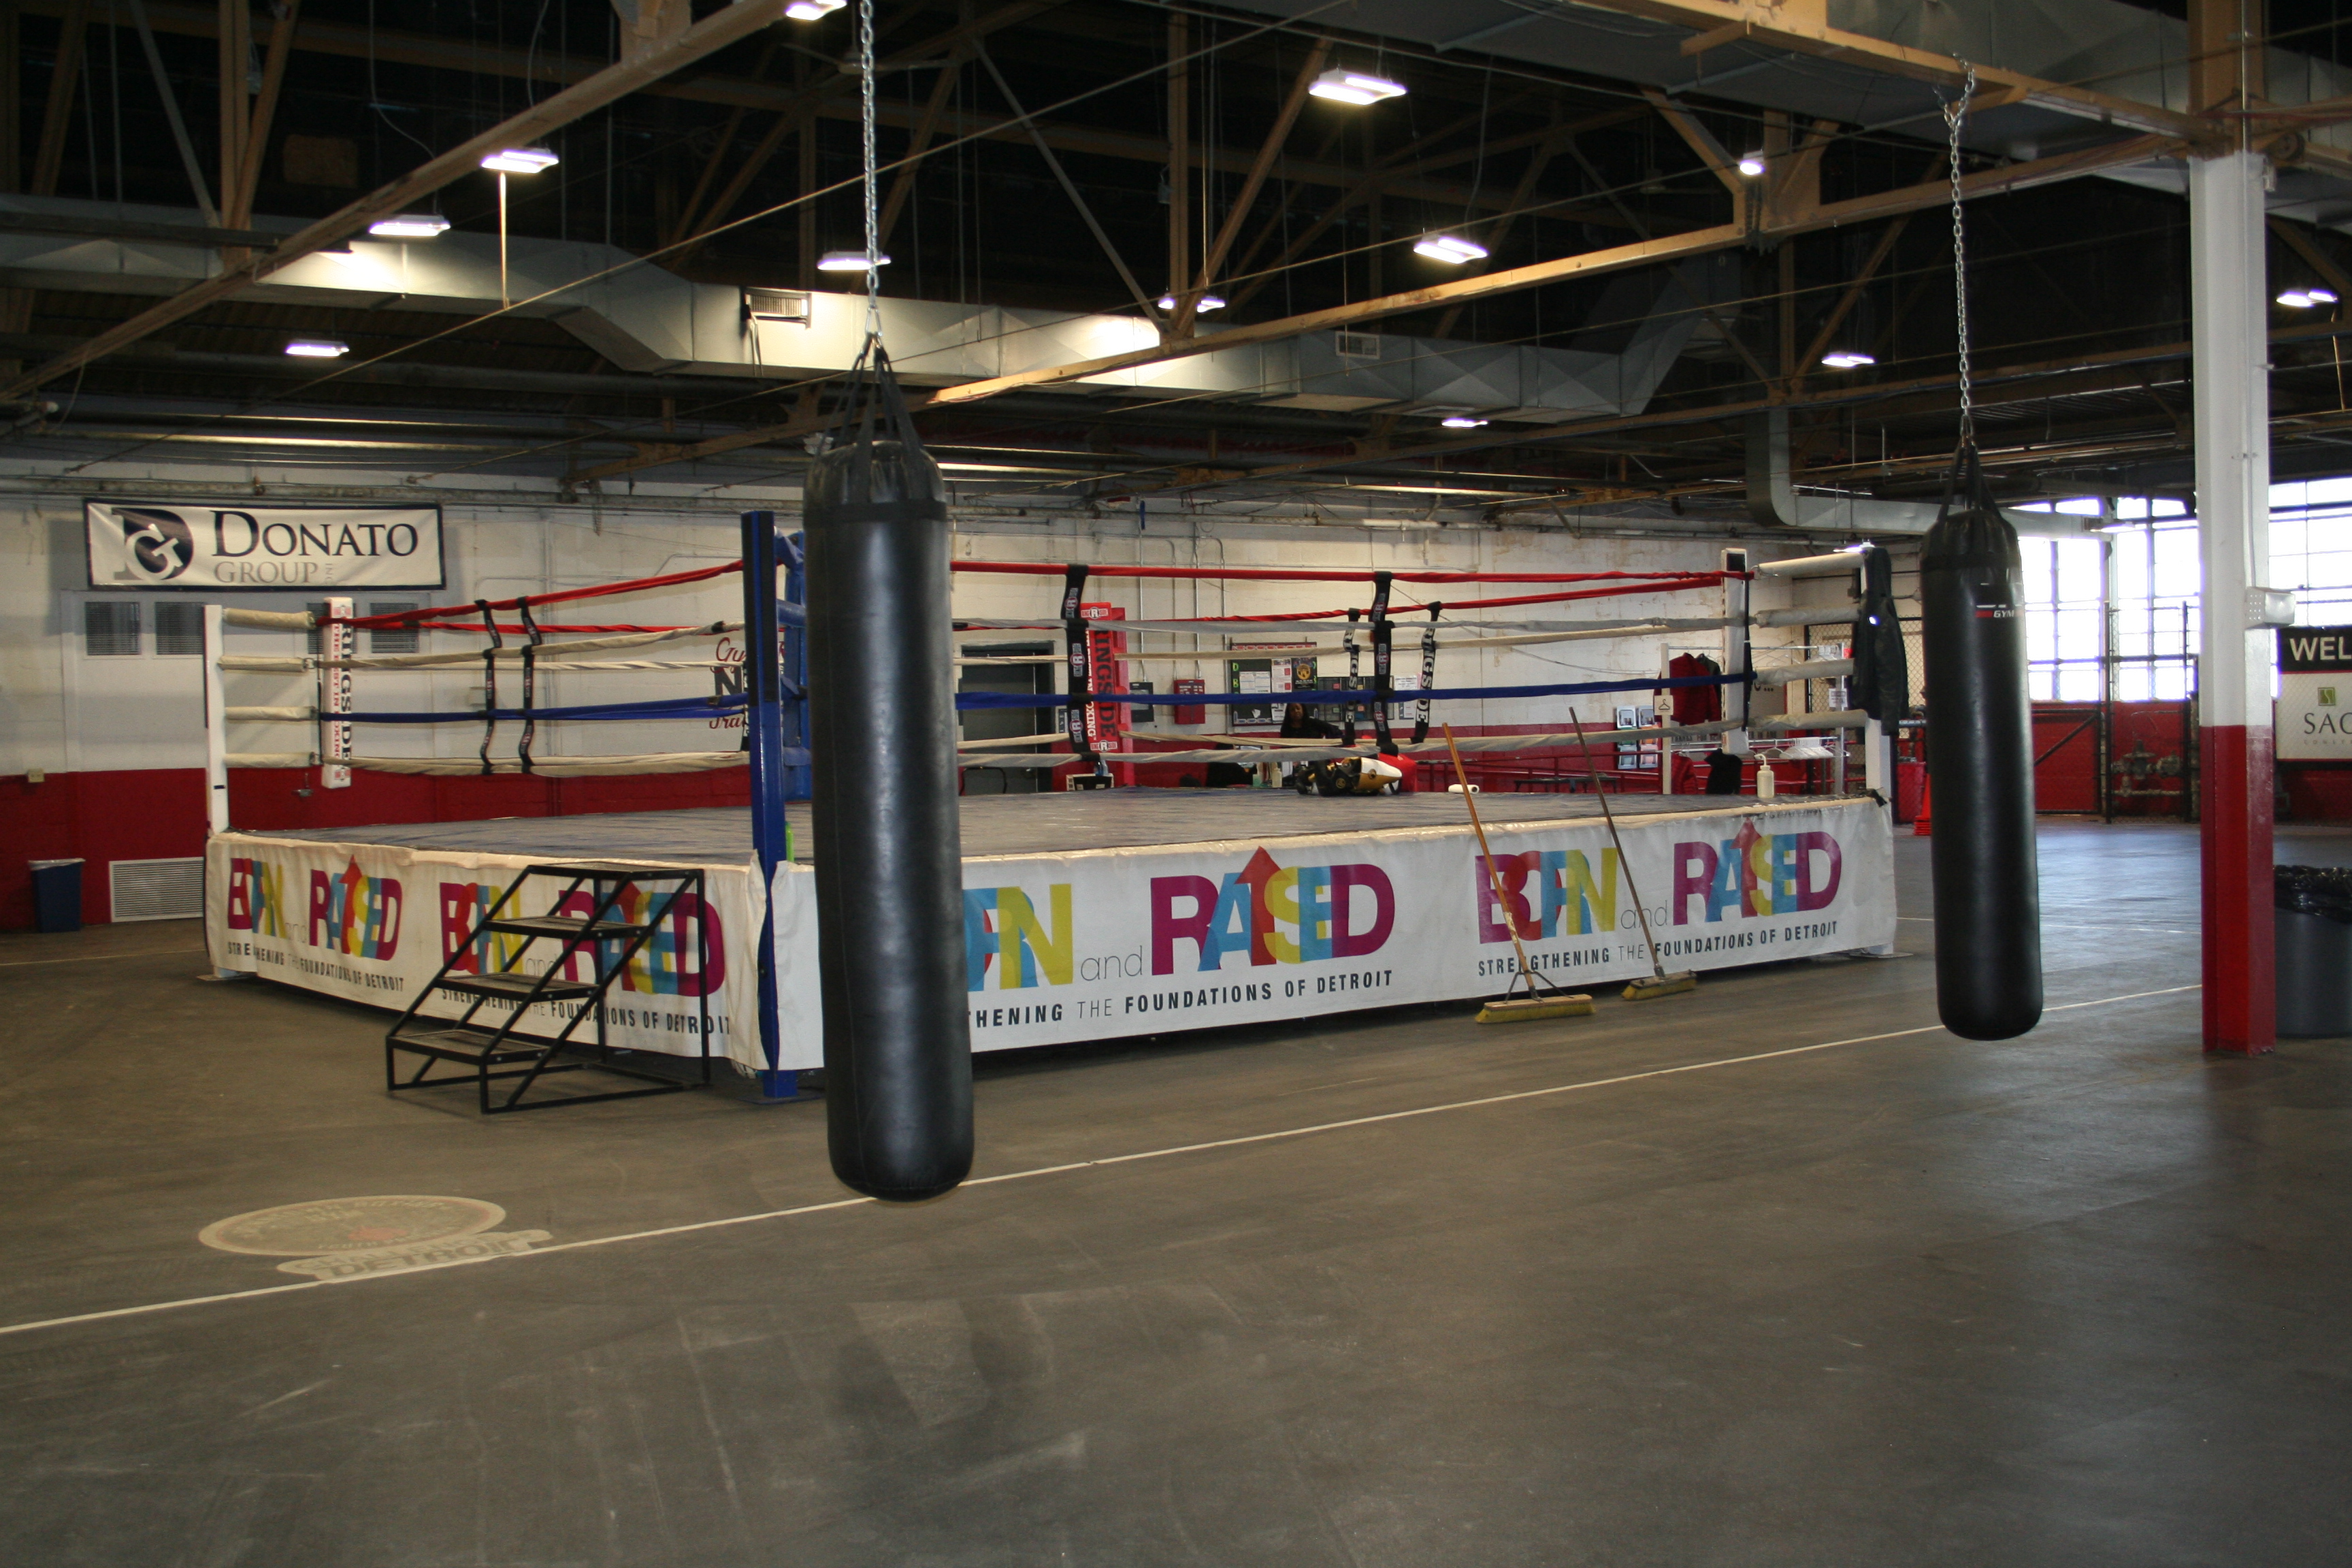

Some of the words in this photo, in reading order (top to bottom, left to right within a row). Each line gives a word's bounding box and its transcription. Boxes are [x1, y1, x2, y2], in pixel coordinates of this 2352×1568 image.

[212, 510, 419, 557] DONATO
[214, 561, 318, 584] GROUP
[1993, 610, 2014, 618] GYM
[1618, 944, 1645, 962] THE
[1654, 933, 1754, 957] FOUNDATIONS
[1760, 929, 1776, 944] OF
[1784, 921, 1838, 941] DETROIT
[353, 970, 362, 985] OF
[365, 973, 404, 992] DETROIT
[1080, 945, 1143, 982] and
[1077, 998, 1114, 1019] THE
[1124, 982, 1273, 1014] FOUNDATIONS
[1284, 980, 1306, 998] OF
[1317, 970, 1393, 994] DETROIT
[643, 1011, 658, 1029] OF
[328, 1239, 521, 1276] DETROIT
